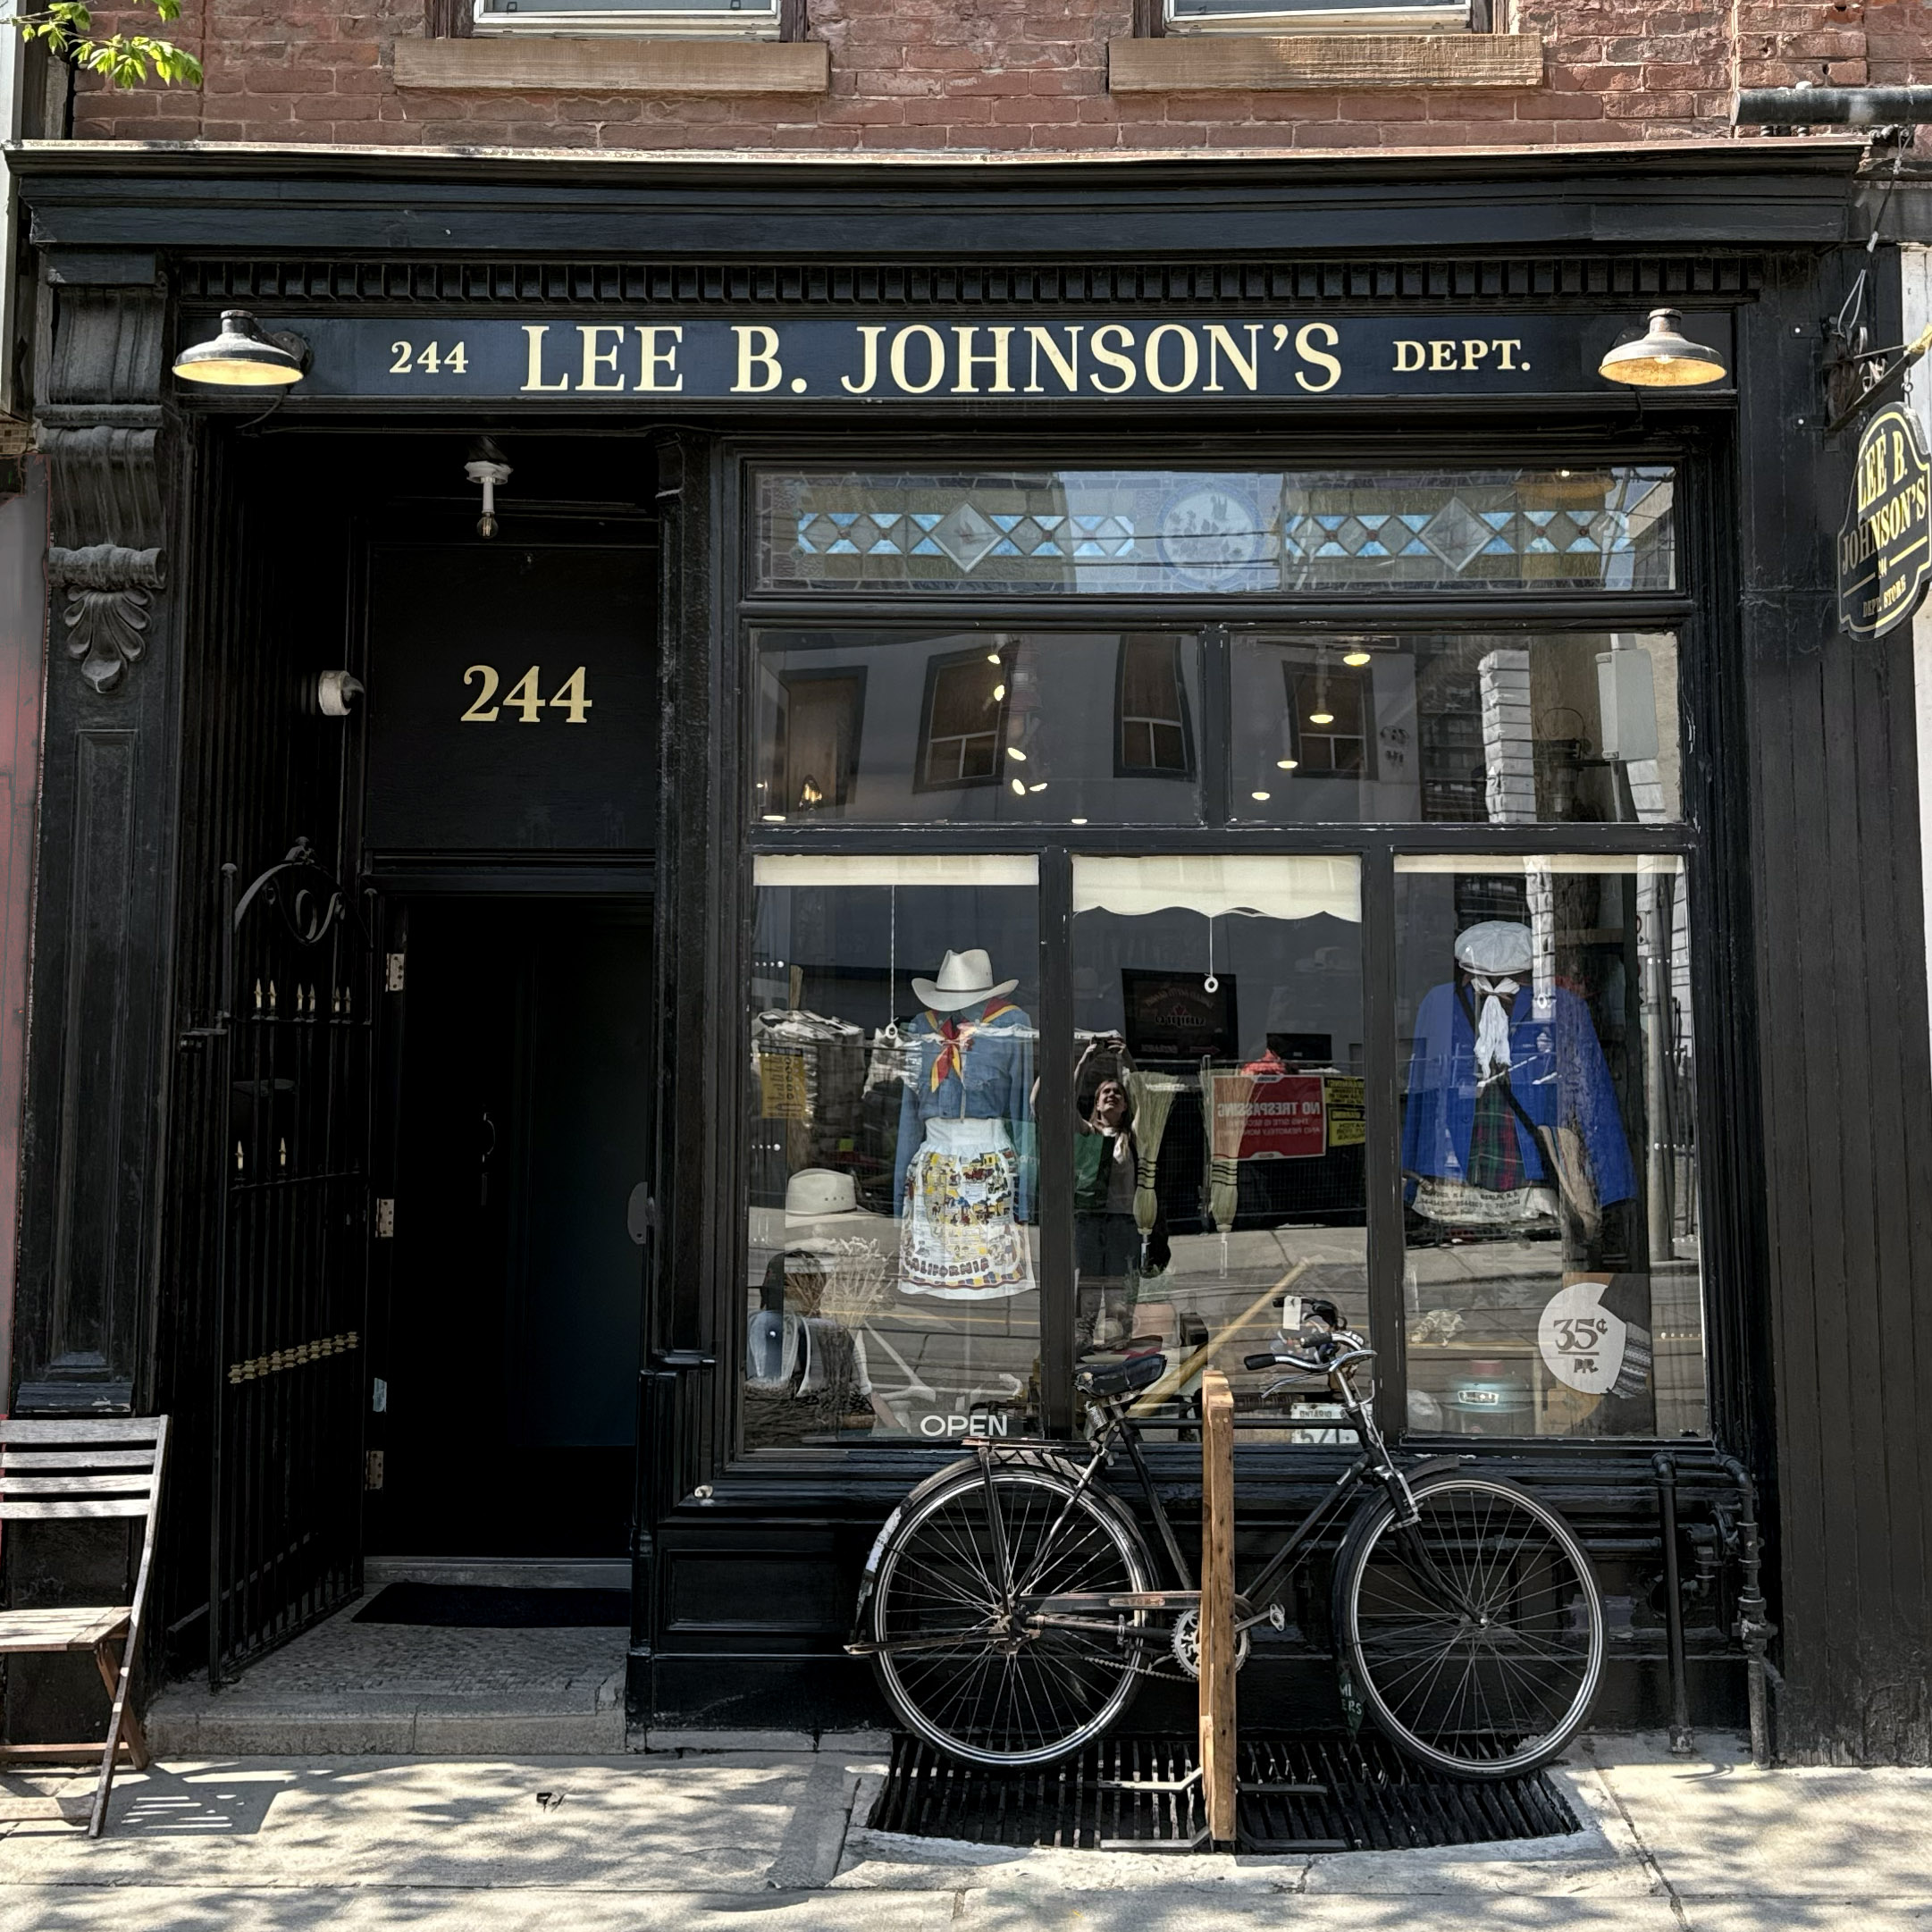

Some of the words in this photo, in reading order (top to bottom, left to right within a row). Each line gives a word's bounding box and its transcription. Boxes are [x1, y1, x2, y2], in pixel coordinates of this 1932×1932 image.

[389, 340, 469, 375] 244
[519, 324, 685, 393] LEE
[729, 325, 808, 394] B.
[840, 322, 1344, 395] JOHNSON'S
[1391, 339, 1532, 373] DEPT.
[1857, 433, 1887, 514] LEE
[1892, 430, 1909, 486] B.
[1841, 474, 1927, 575] JOHNSON'S
[1882, 574, 1907, 610] STORE
[459, 664, 593, 724] 244
[1552, 1317, 1609, 1351] 35¢
[1573, 1358, 1600, 1374] PR.
[920, 1415, 1009, 1437] OPEN
[1298, 1409, 1333, 1418] ONTARIO
